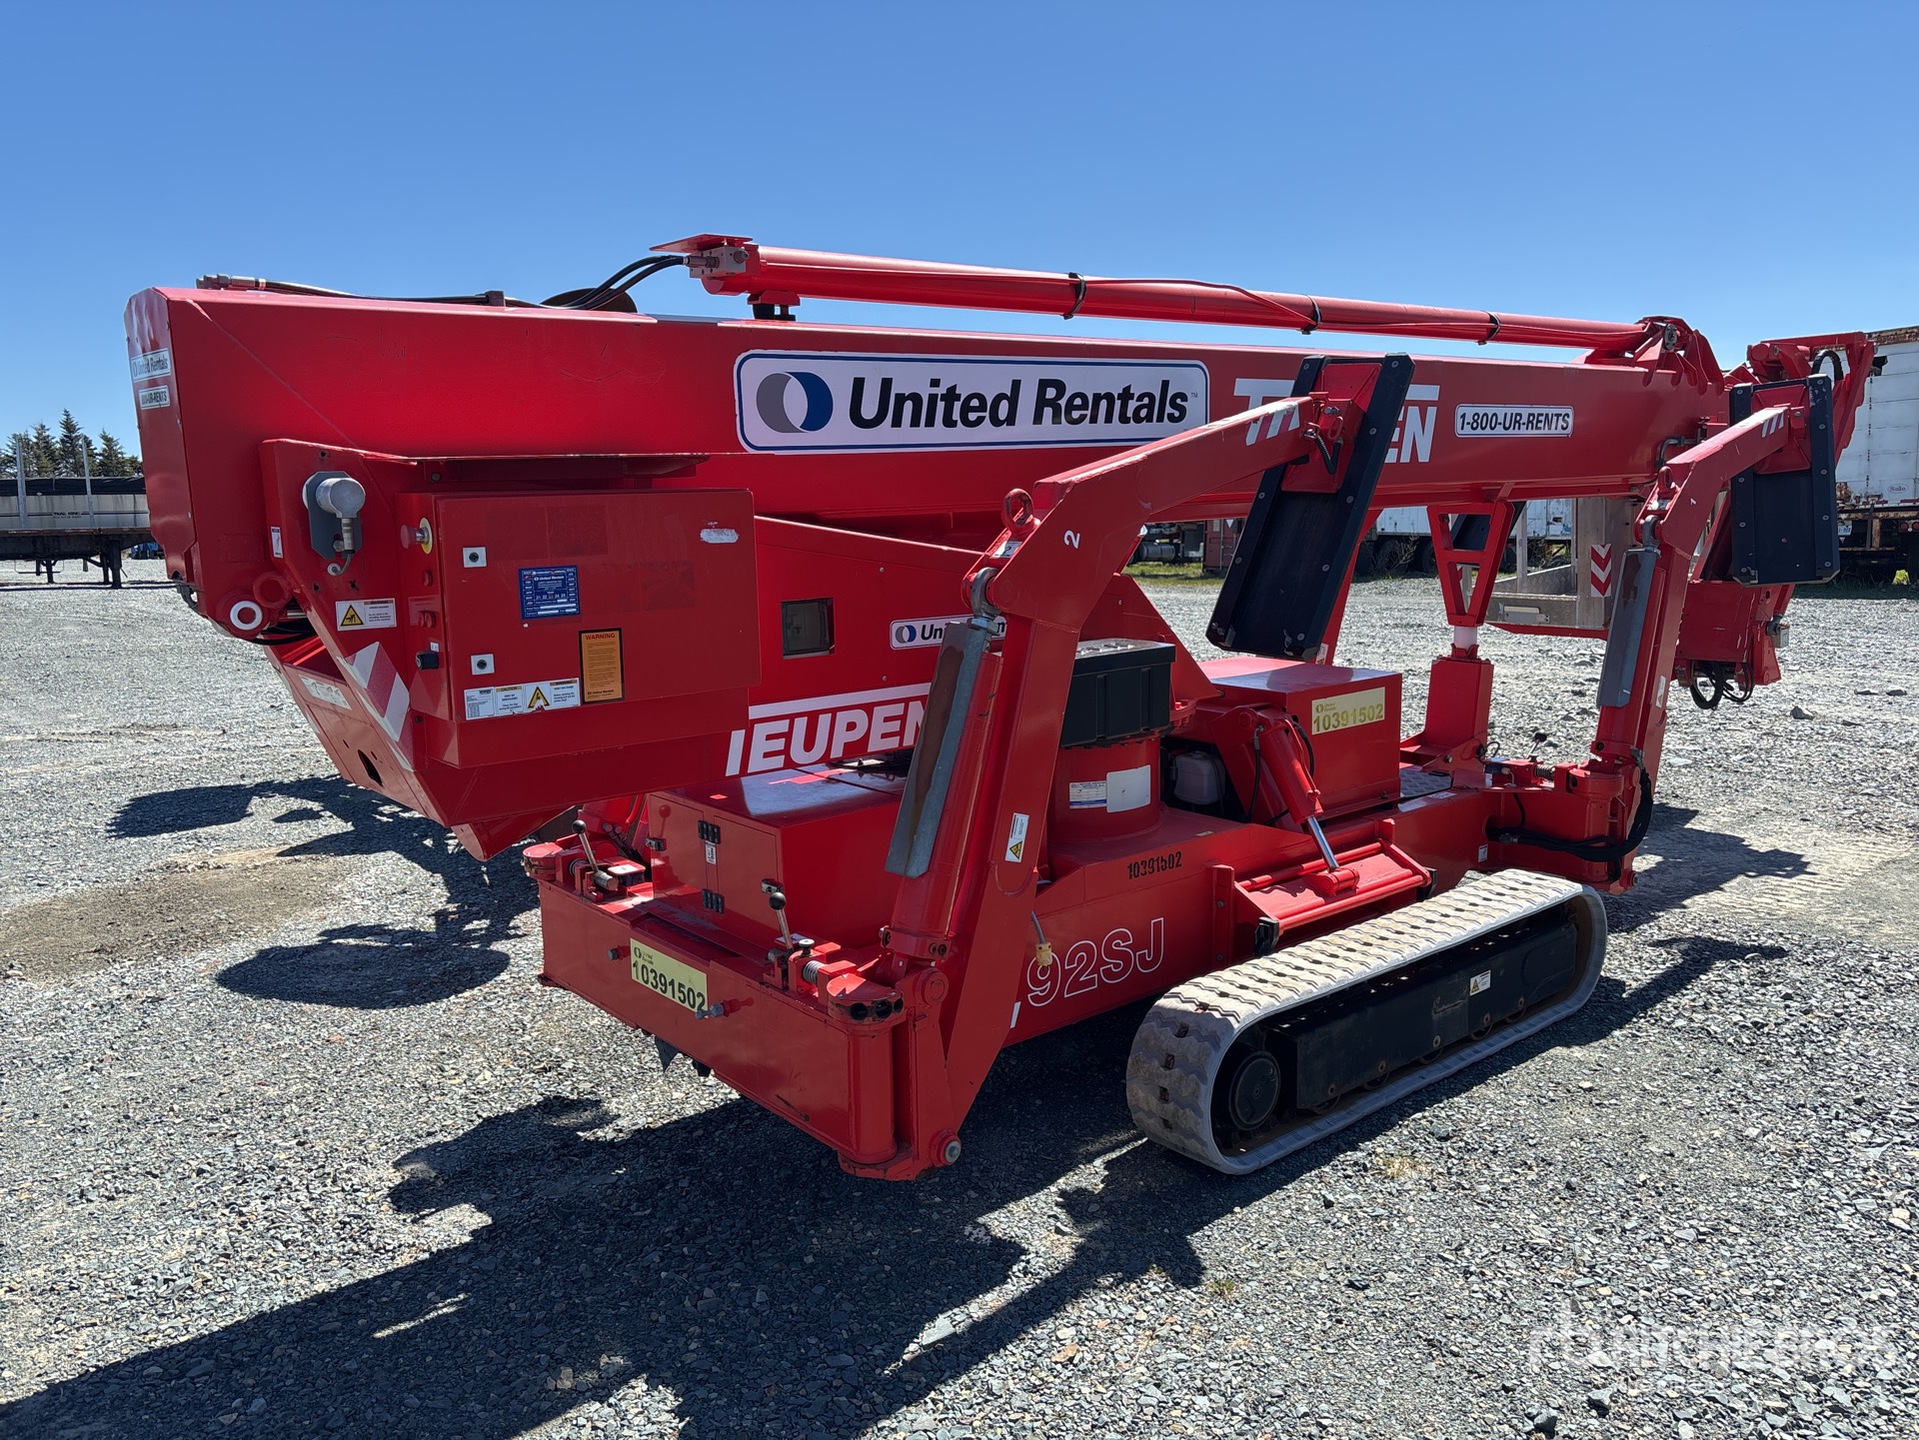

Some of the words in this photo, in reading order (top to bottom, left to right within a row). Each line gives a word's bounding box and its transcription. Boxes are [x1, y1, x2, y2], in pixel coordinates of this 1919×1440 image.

[848, 376, 1021, 429] United
[1032, 377, 1188, 426] Rentals
[1459, 411, 1571, 432] 1-800-UR-RENTS
[1063, 529, 1081, 550] 2
[1313, 702, 1385, 733] 10391502
[1127, 851, 1183, 880] 10391502
[1026, 917, 1165, 1008] 92SJ
[632, 959, 706, 1014] 10391502
